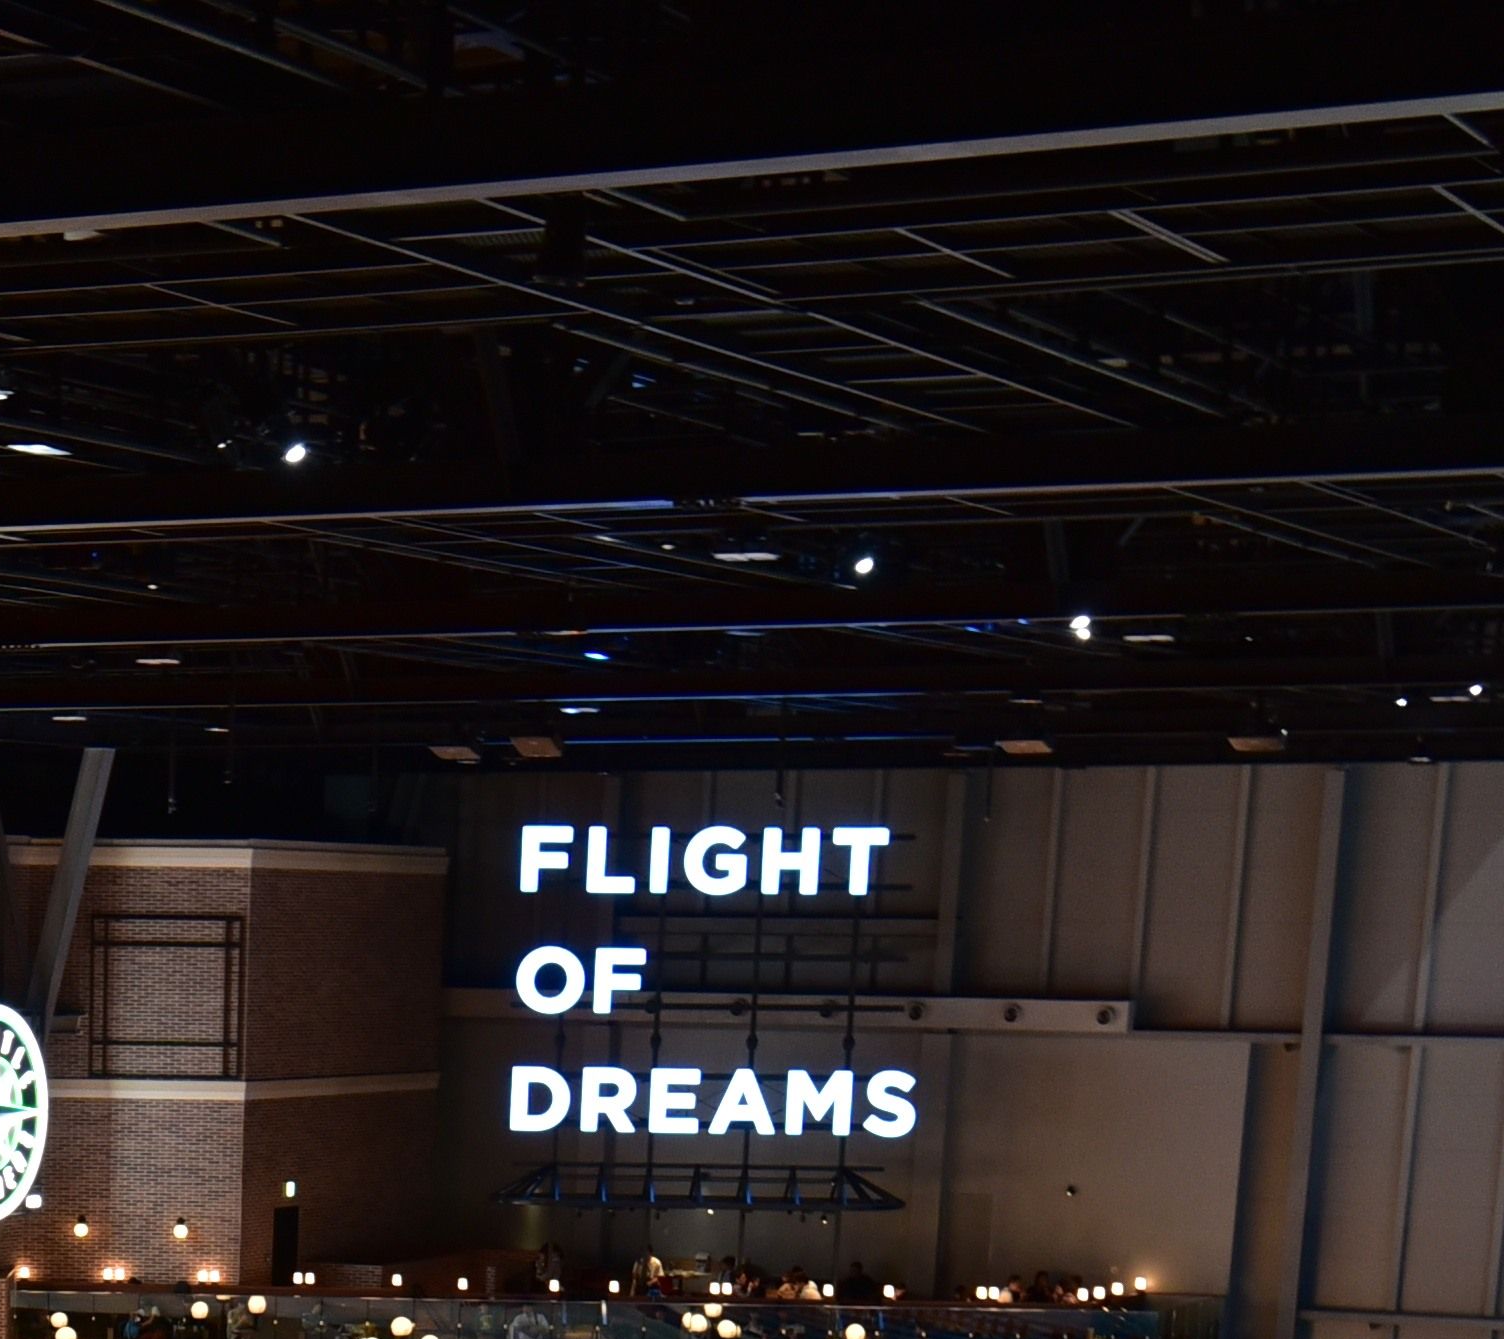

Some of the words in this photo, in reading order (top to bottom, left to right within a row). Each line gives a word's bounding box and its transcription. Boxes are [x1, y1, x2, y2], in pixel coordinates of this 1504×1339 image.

[518, 825, 891, 896] FLIGHT
[515, 945, 648, 1015] OF
[508, 1065, 917, 1138] DREAMS
